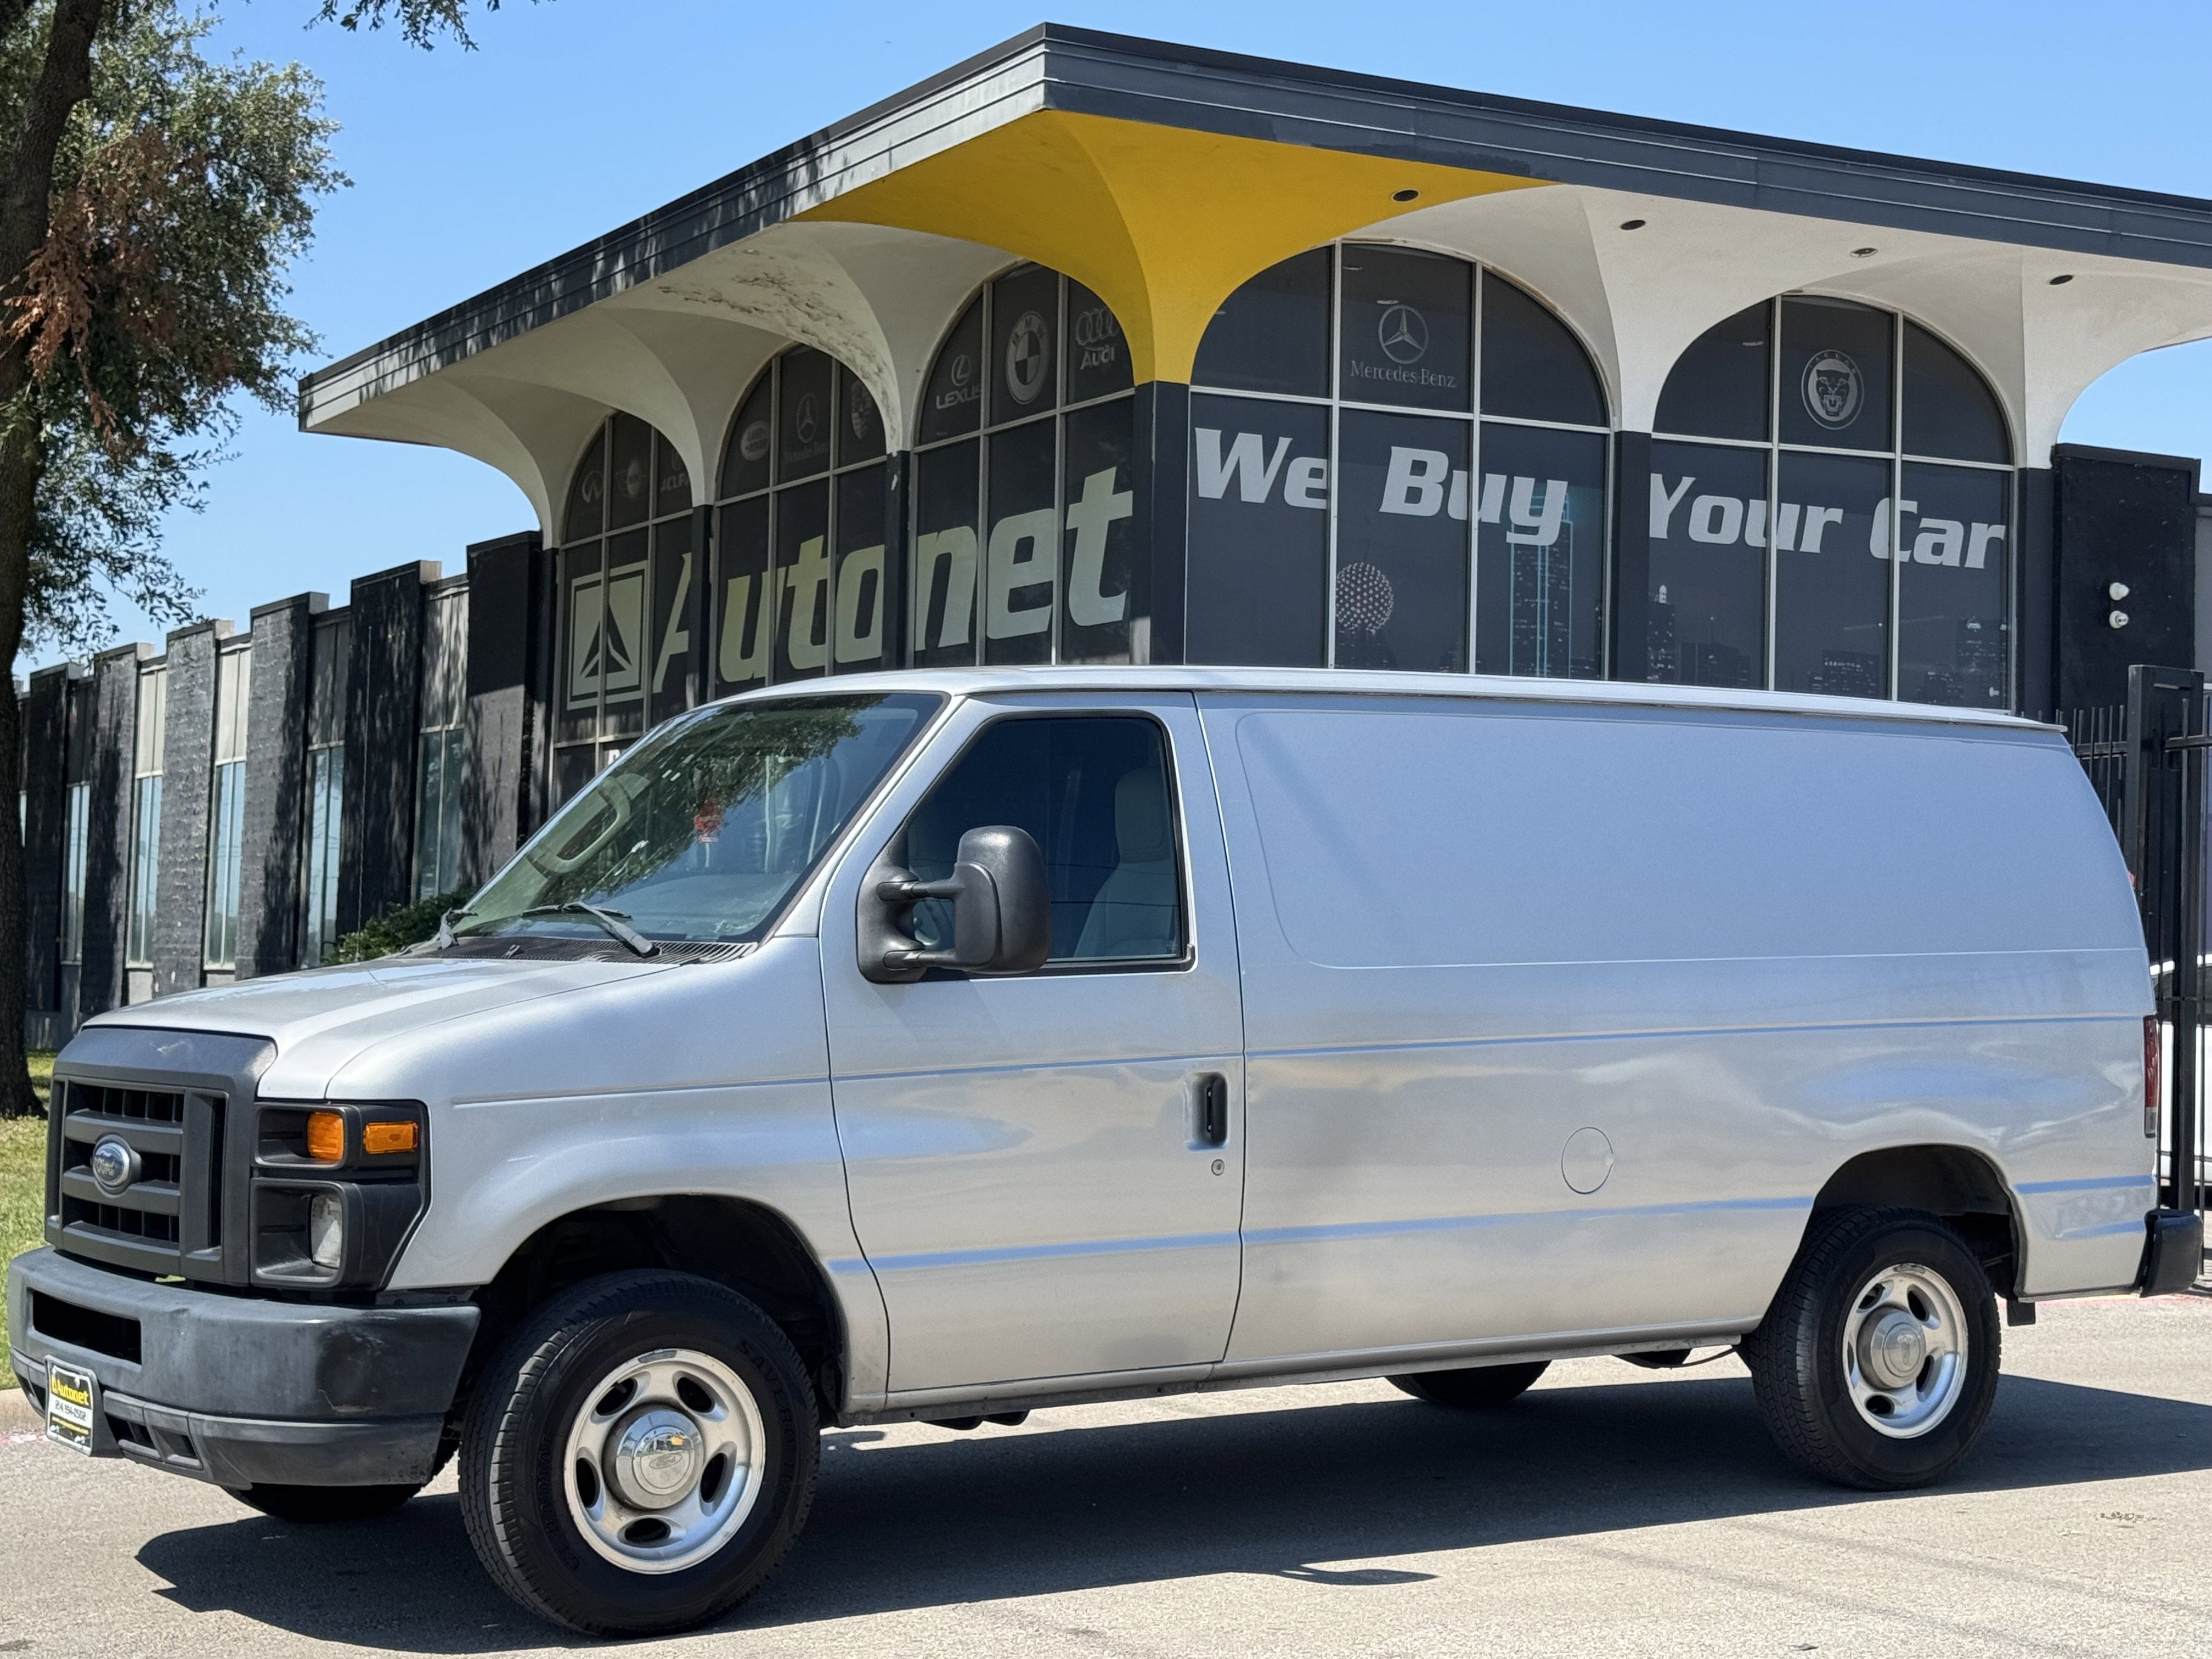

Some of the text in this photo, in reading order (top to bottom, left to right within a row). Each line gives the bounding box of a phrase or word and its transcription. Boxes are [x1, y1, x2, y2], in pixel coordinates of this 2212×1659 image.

[1080, 345, 1115, 370] Audi
[1350, 360, 1457, 388] Mercedes-Benz
[936, 383, 981, 409] LEXUS
[1194, 427, 2006, 569] We Buy Your Car
[57, 1379, 89, 1406] Autonet
